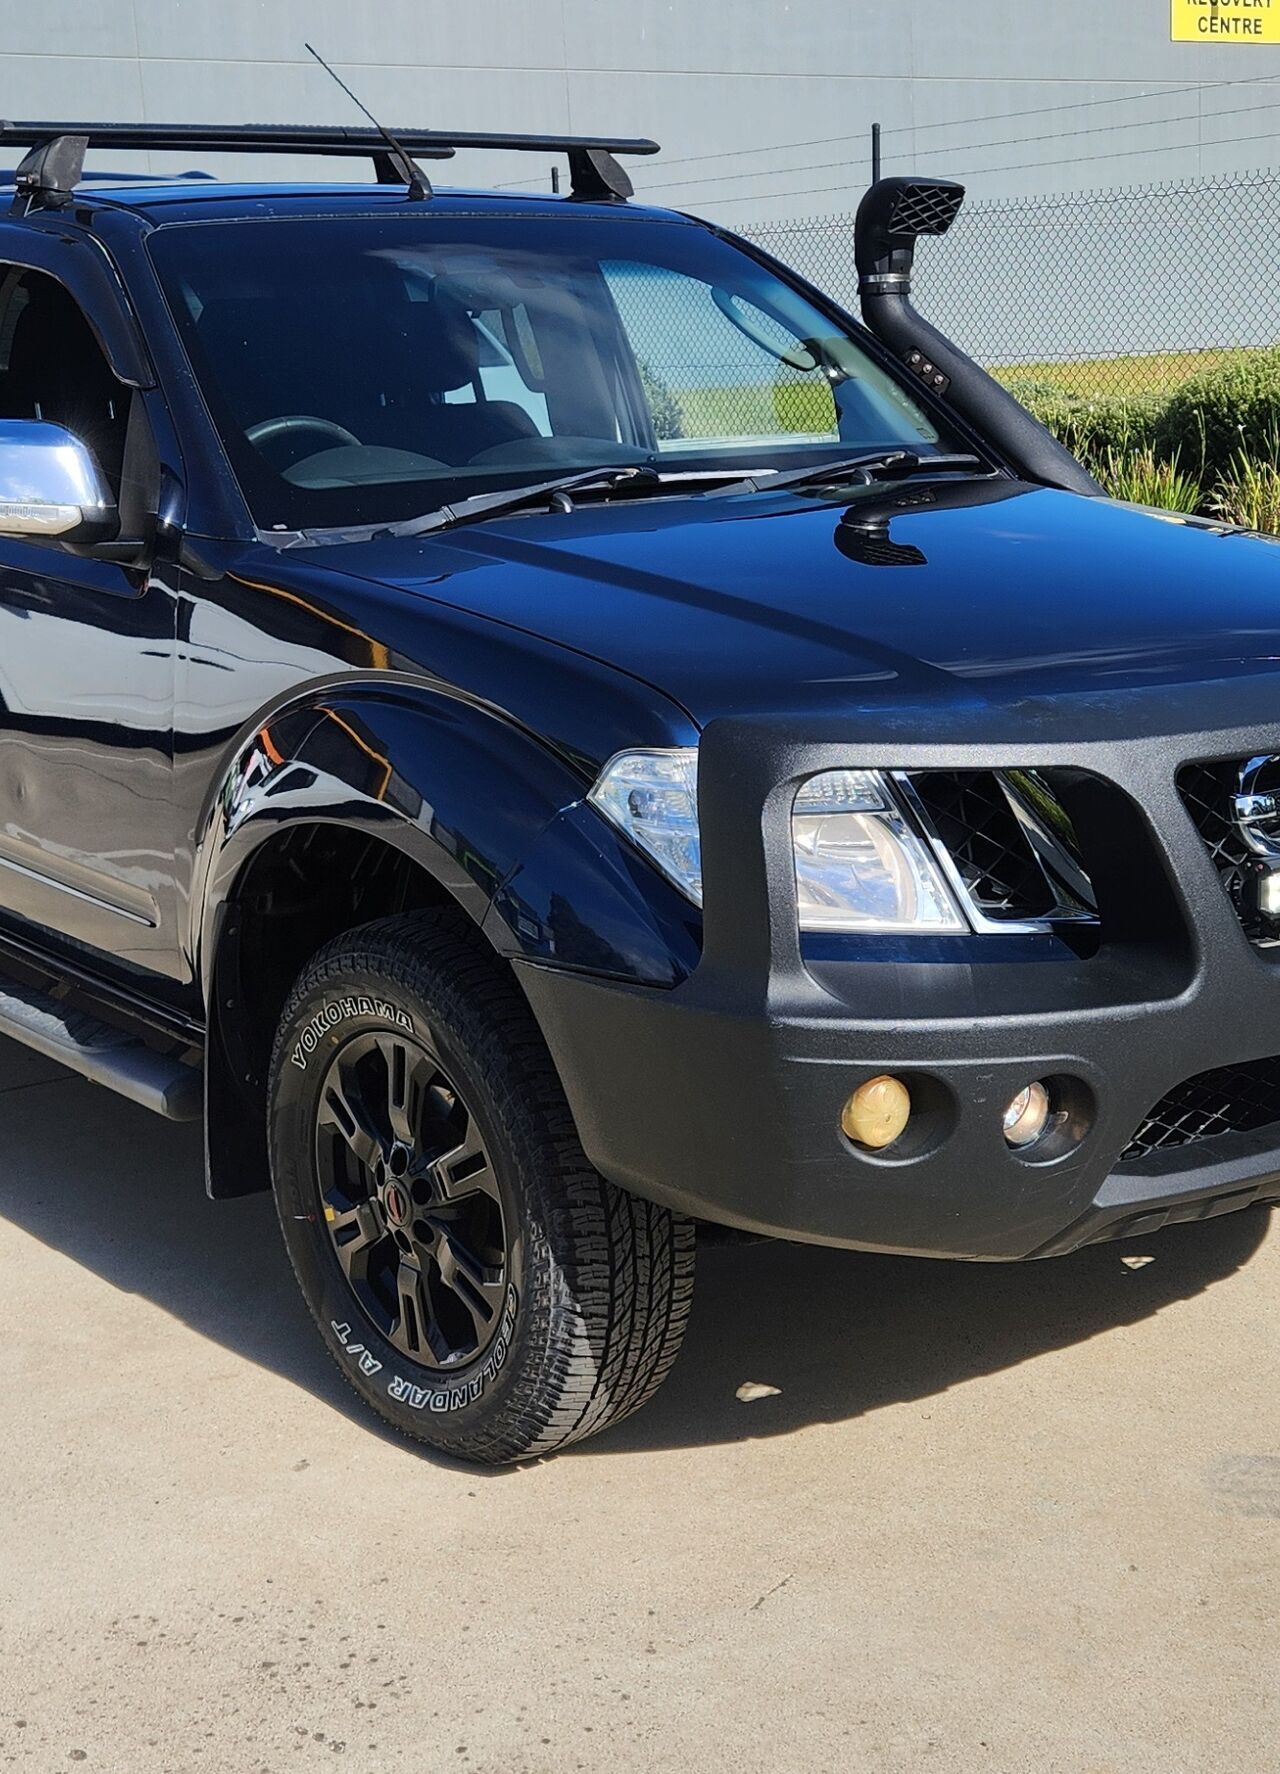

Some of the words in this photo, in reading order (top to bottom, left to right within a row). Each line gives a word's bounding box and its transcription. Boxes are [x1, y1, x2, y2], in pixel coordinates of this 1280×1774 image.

[1198, 16, 1262, 34] CENTRE
[291, 997, 414, 1070] YOKOHAMA
[331, 1320, 383, 1376] A/T
[387, 1283, 518, 1412] GEOLANDAR
